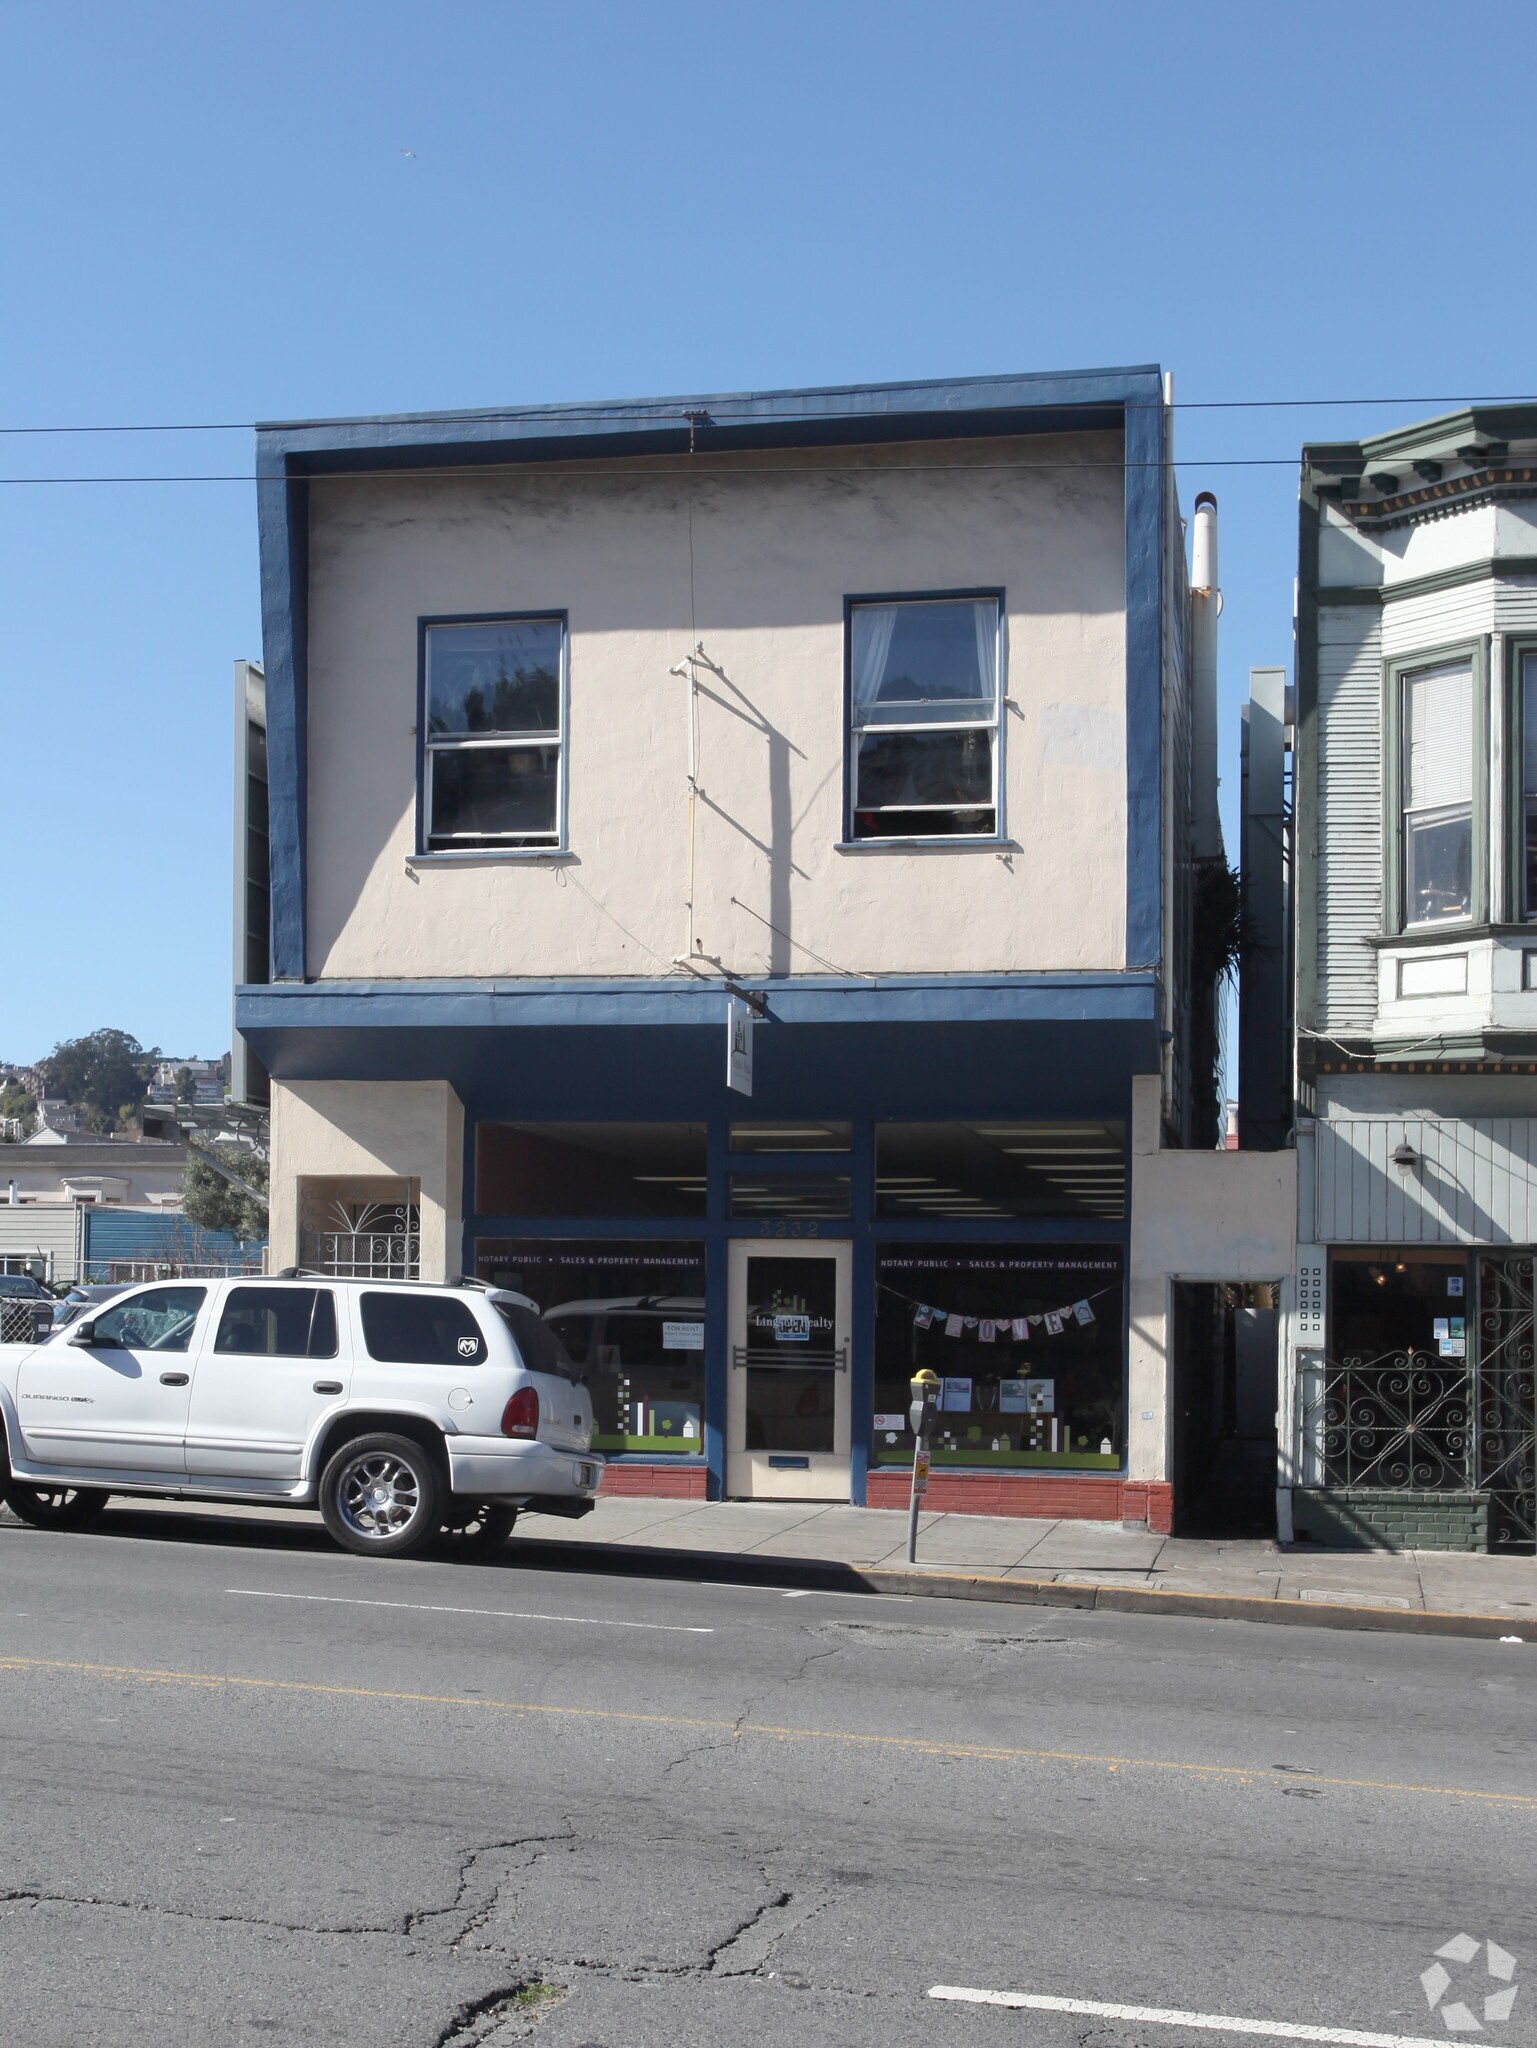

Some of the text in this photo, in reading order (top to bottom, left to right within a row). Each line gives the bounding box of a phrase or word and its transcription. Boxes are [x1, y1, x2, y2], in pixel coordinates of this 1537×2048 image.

[478, 1255, 509, 1263] NOTARY
[560, 1256, 585, 1264] SALES
[597, 1257, 640, 1265] PROPERTY
[969, 1260, 996, 1268] SALES
[1009, 1261, 1054, 1269] PROPERTY
[1057, 1261, 1118, 1269] MANAGEMENT
[800, 1316, 834, 1330] Realty
[21, 1393, 70, 1402] DURANGO
